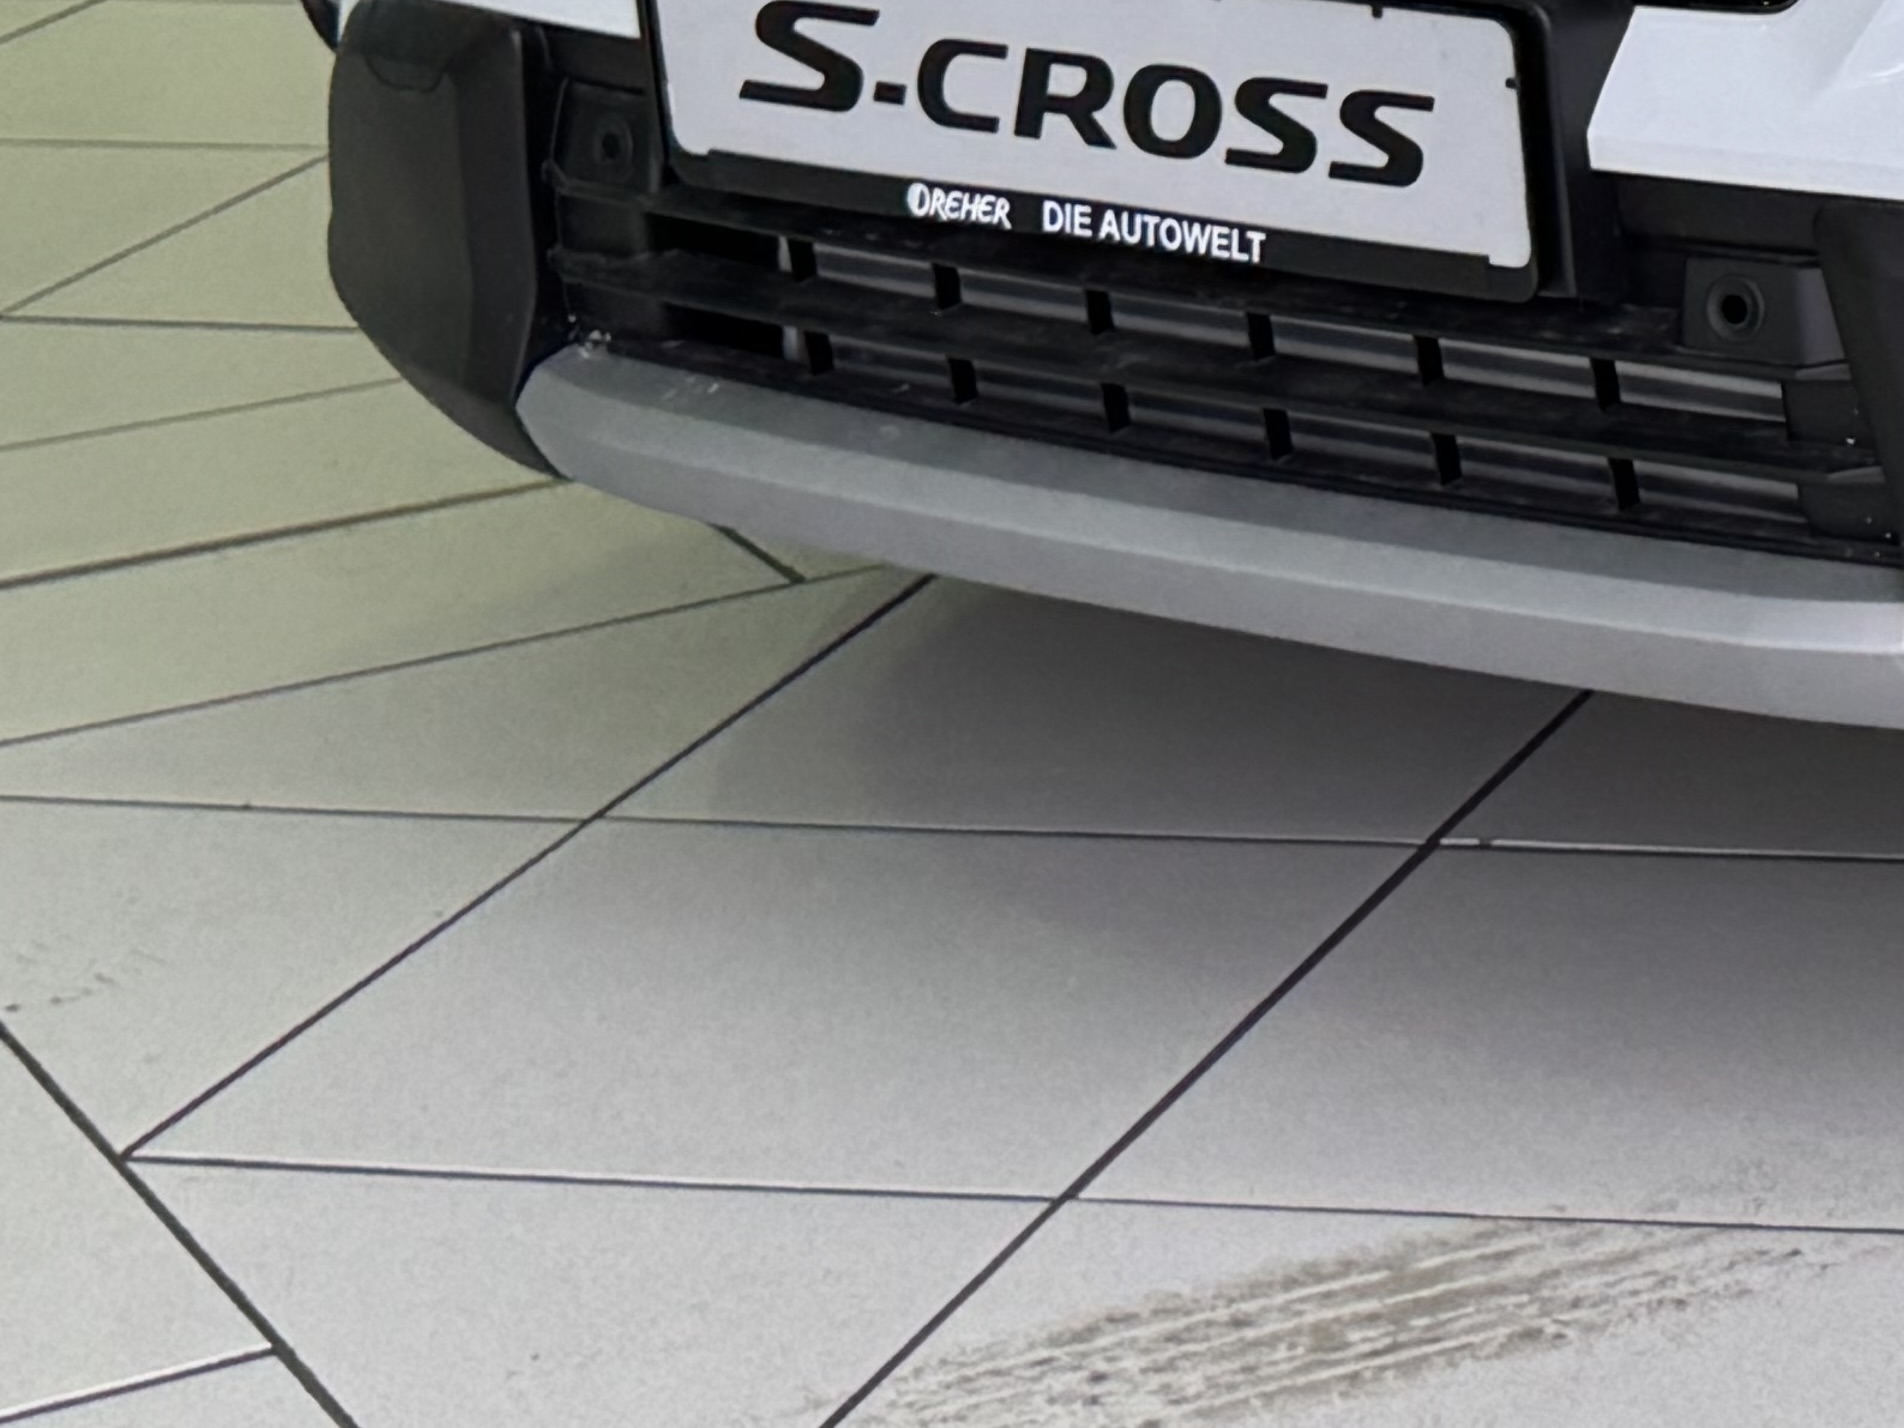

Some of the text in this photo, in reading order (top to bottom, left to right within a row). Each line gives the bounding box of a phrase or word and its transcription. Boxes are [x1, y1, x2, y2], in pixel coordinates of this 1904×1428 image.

[907, 181, 1266, 264] DREHER DIE AUTOWELT
